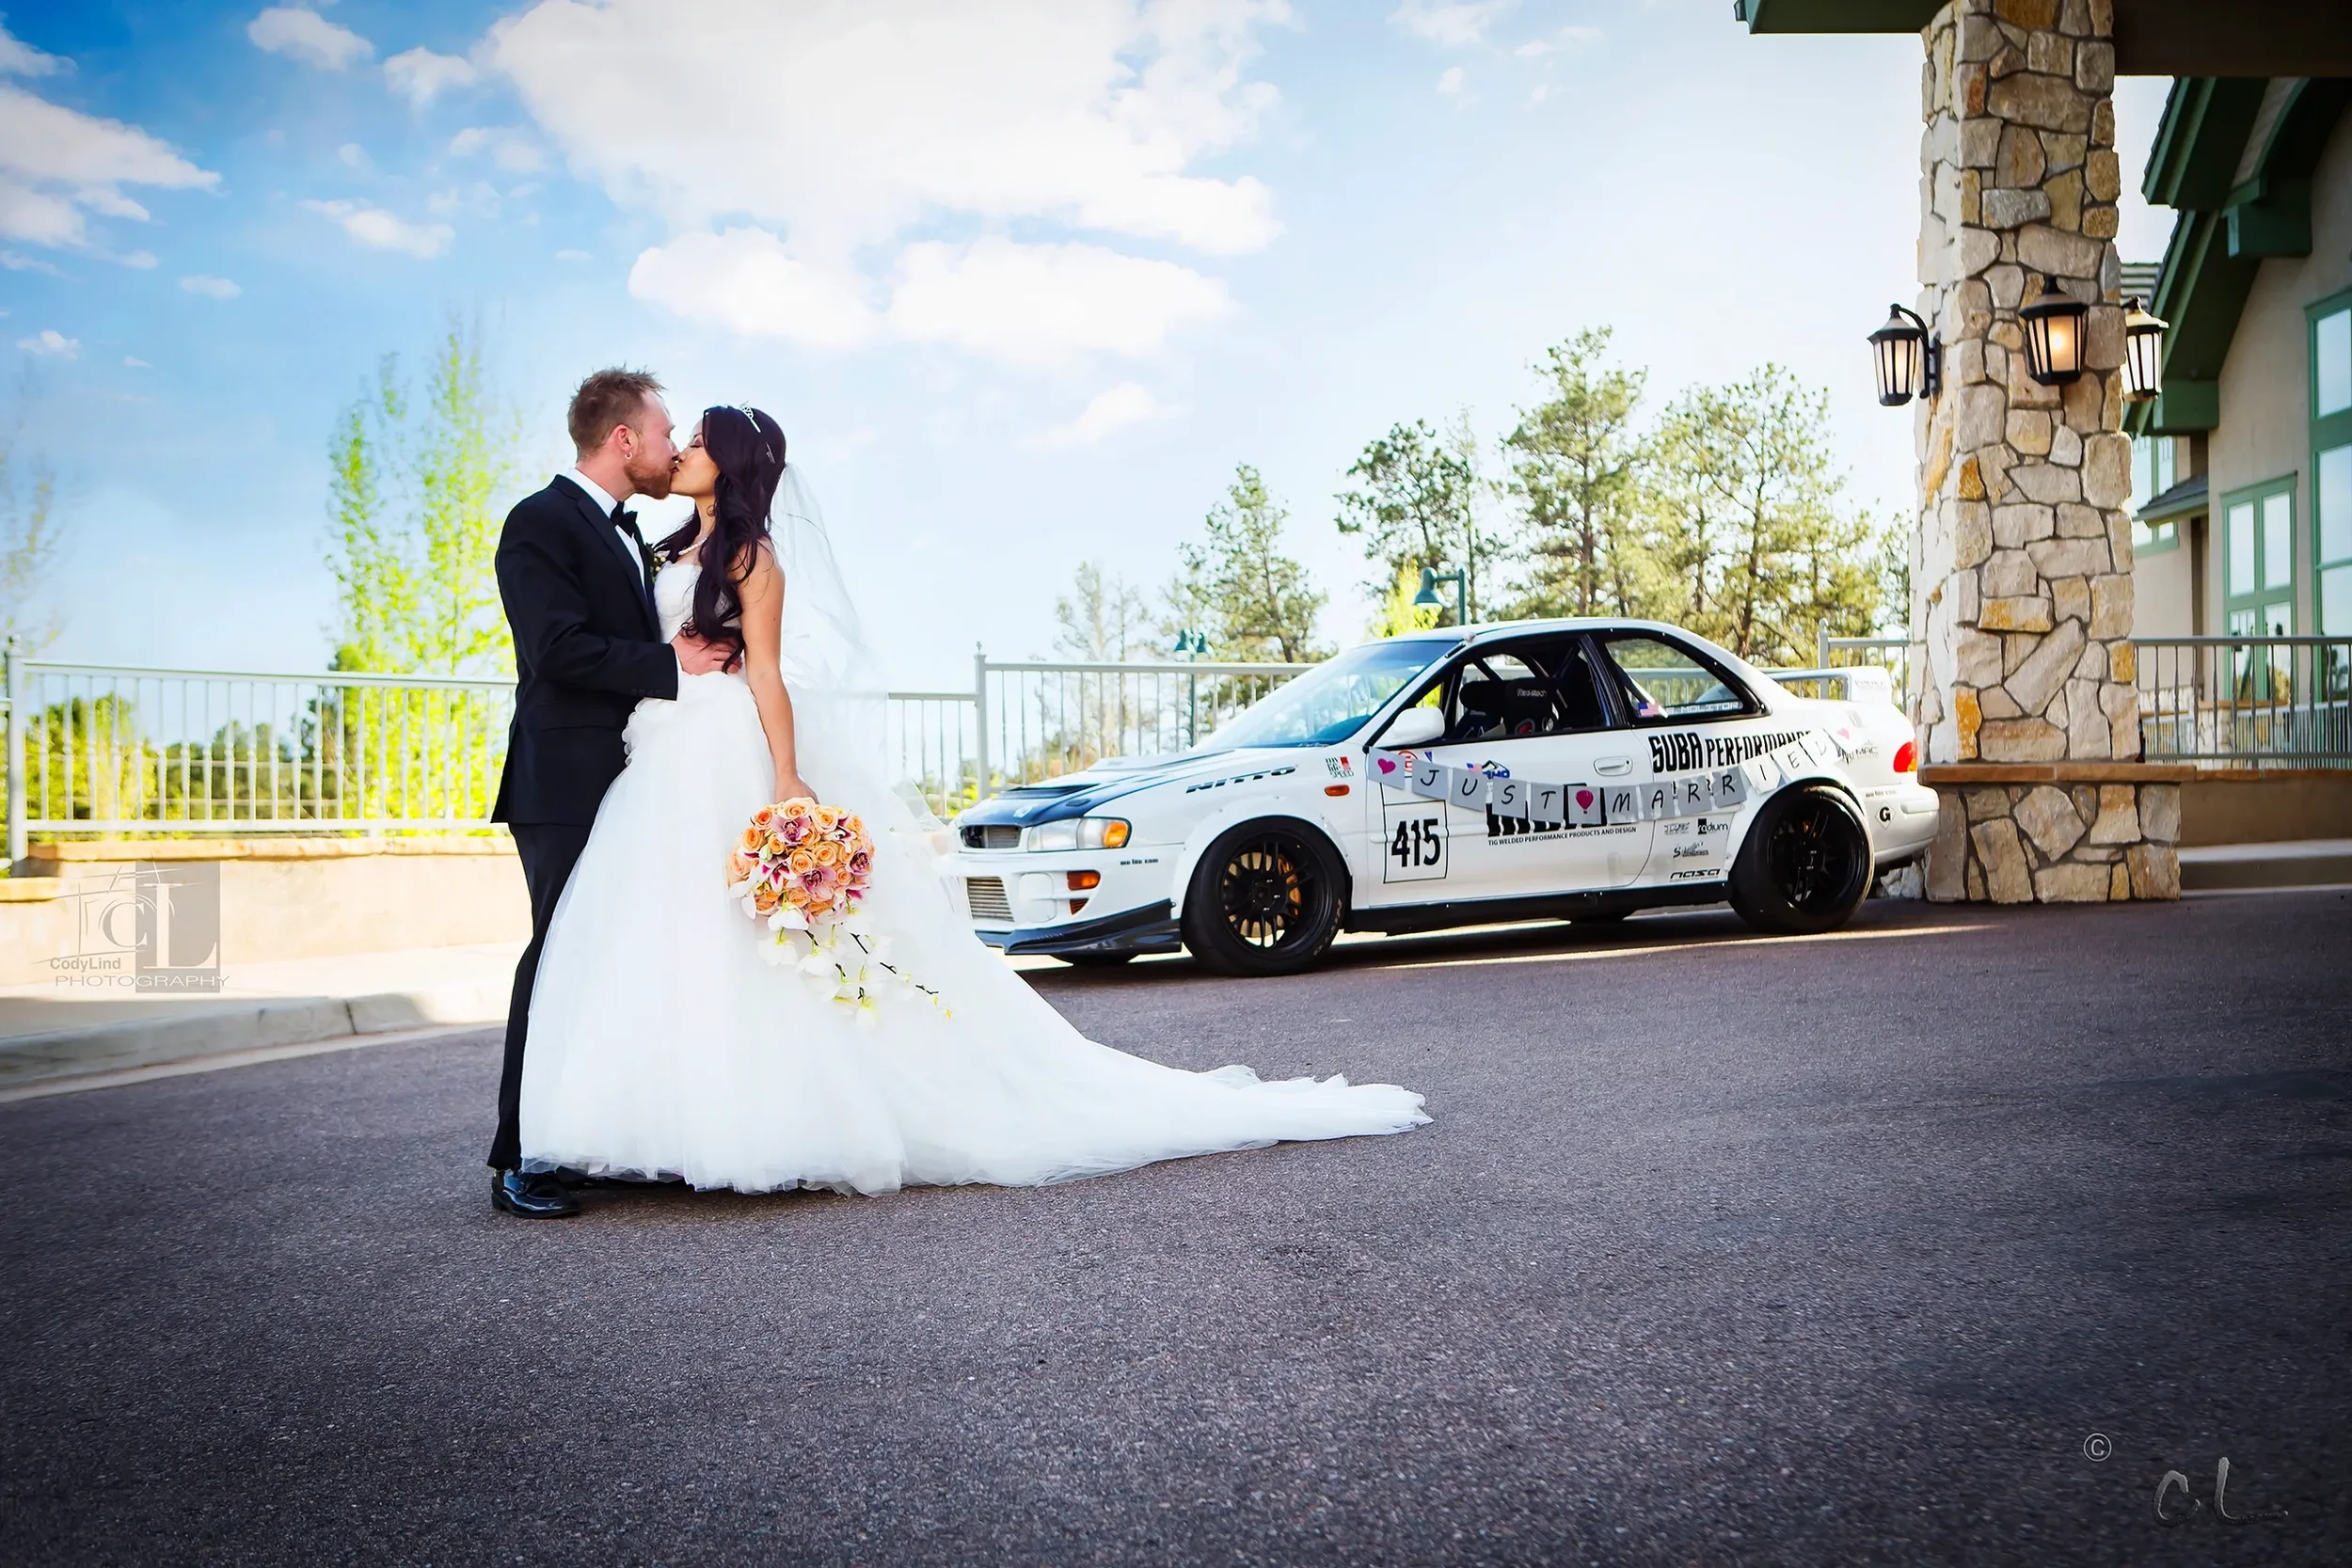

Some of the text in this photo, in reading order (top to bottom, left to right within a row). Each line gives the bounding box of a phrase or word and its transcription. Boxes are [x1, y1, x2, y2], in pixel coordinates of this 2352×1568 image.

[1647, 732, 1704, 773] SUBA
[1879, 806, 1891, 822] G
[1391, 817, 1440, 867] 415
[1499, 837, 1524, 846] WELDED
[1524, 832, 1568, 843] PERFORMANCE
[1568, 829, 1600, 838] PRODUCTS
